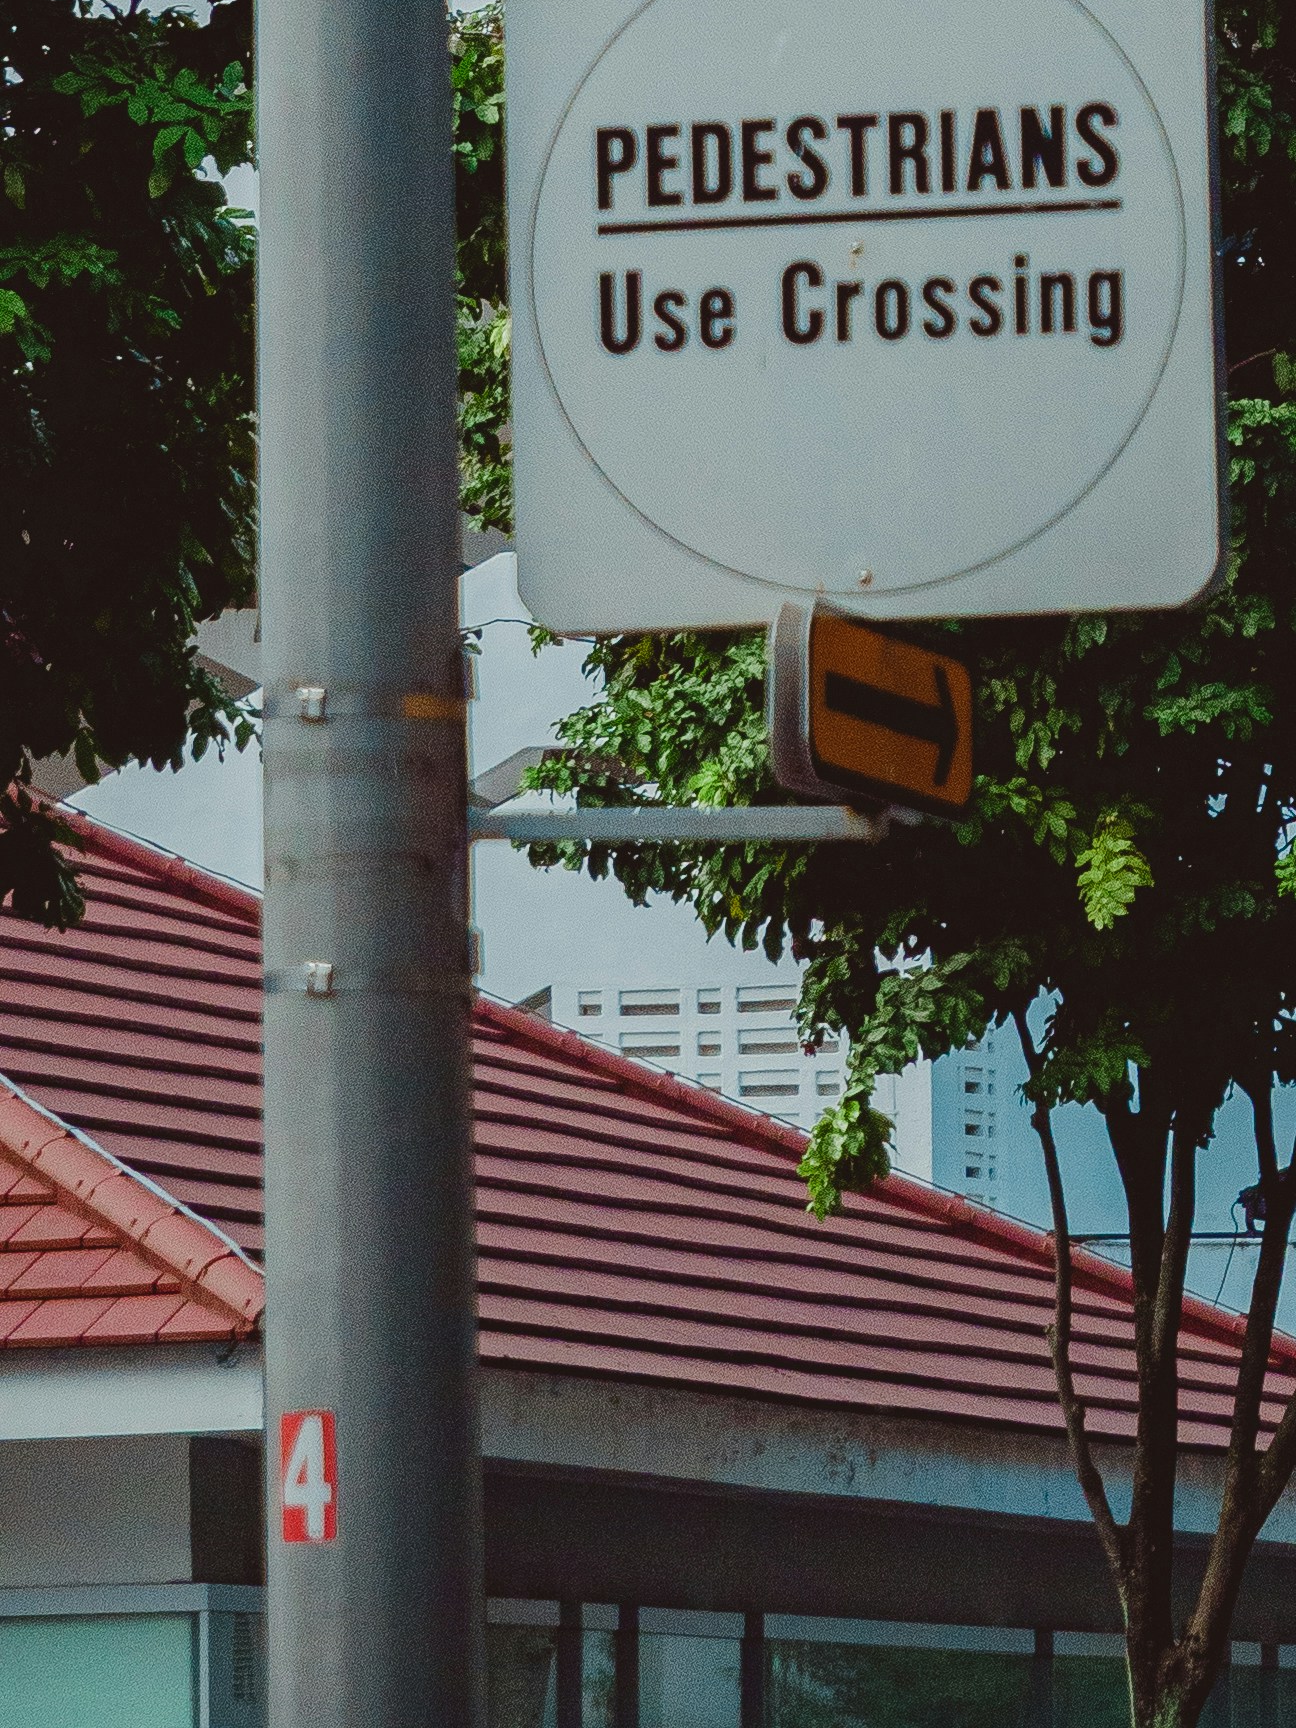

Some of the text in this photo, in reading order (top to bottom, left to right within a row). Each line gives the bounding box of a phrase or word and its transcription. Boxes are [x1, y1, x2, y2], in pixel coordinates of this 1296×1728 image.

[596, 102, 1121, 210] PEDESTRIANS
[599, 254, 1124, 355] Use Crossing
[284, 1414, 331, 1539] 4
